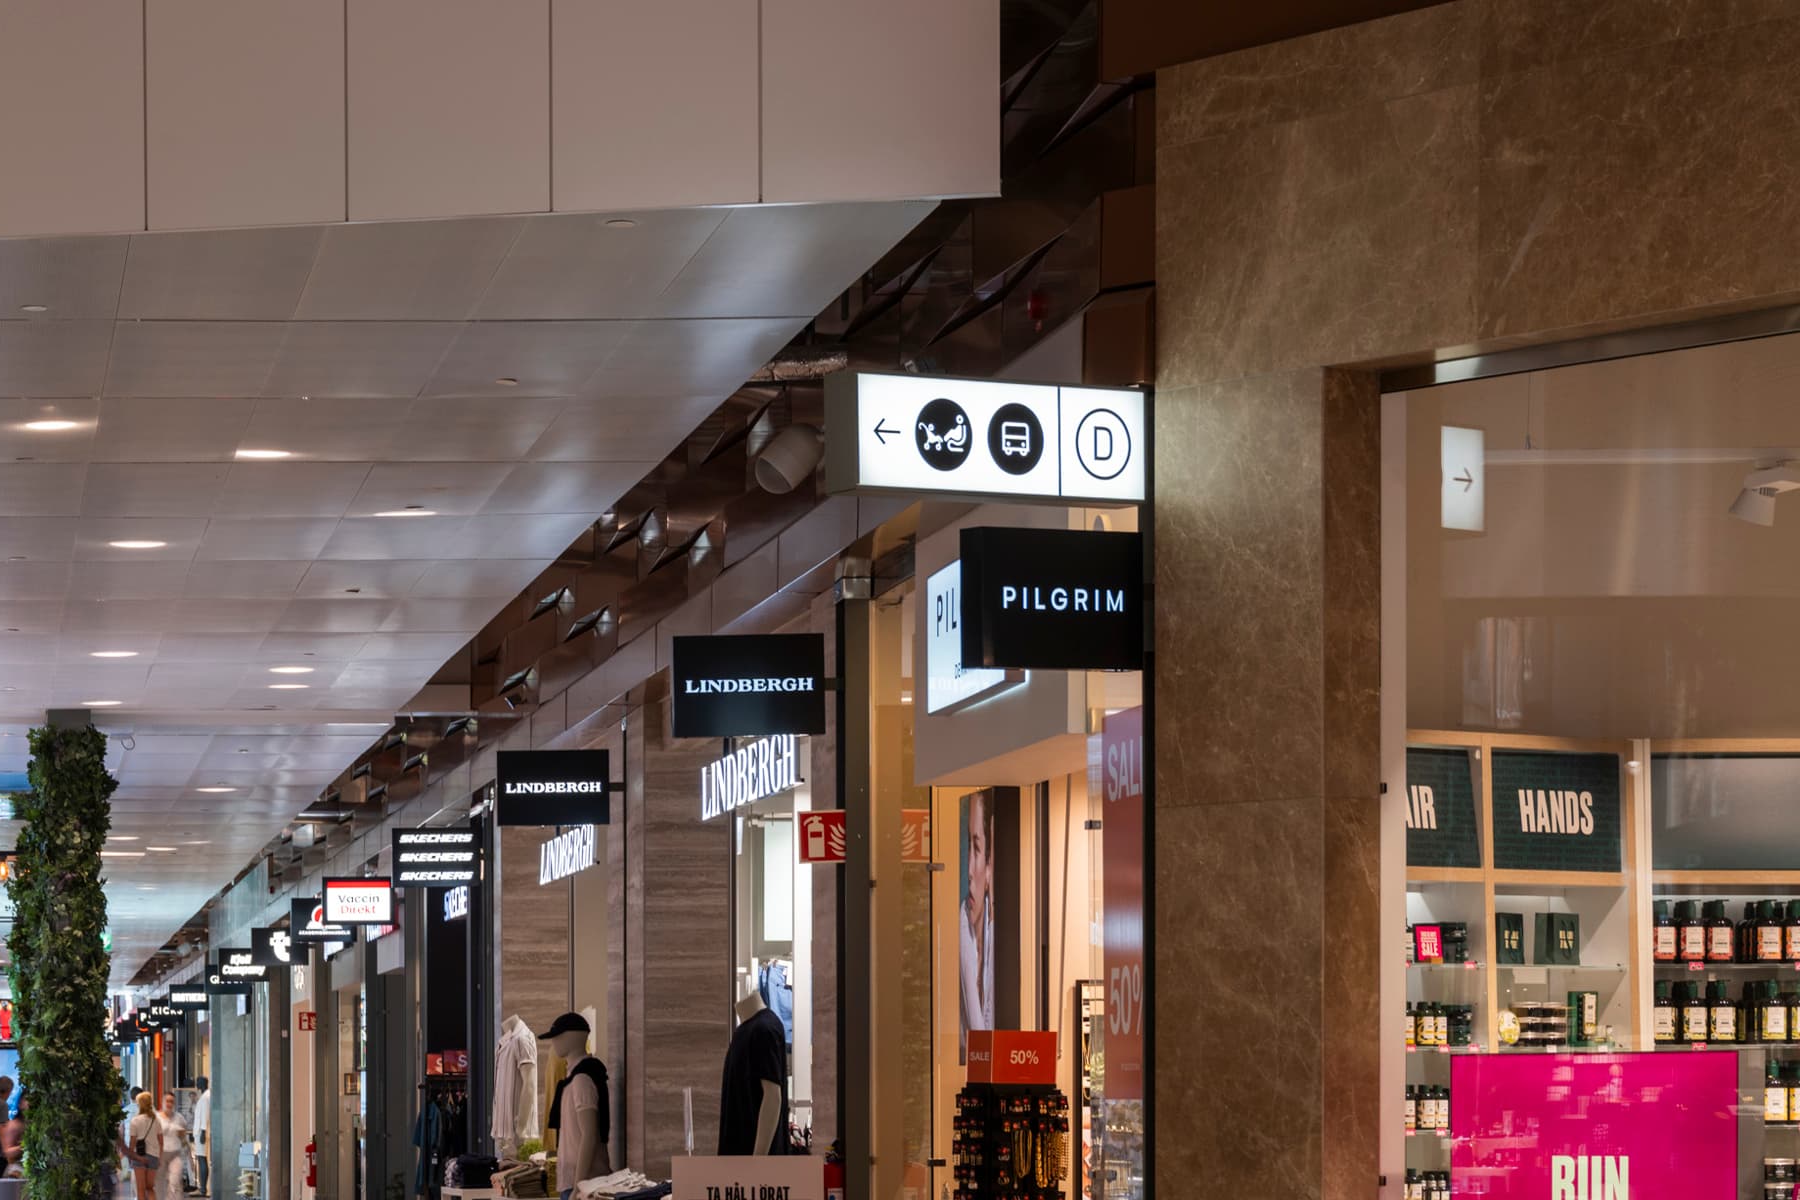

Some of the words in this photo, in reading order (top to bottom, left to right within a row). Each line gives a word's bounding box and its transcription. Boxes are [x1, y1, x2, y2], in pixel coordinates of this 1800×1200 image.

[1094, 426, 1113, 462] D
[1002, 586, 1125, 612] PILGRIM
[685, 677, 814, 694] LINDBERGH
[701, 733, 796, 821] LINDBERGH
[1107, 735, 1142, 802] SAL
[505, 781, 602, 795] LINDBERGH
[1406, 785, 1438, 830] AIR
[1518, 788, 1595, 836] HANDS
[399, 834, 474, 843] SKECHERS
[399, 852, 474, 862] SKECHERS
[539, 824, 595, 886] LINDBERGH
[399, 871, 474, 881] SKECHERS
[338, 895, 380, 903] Vaccin
[340, 905, 377, 914] Direkt
[969, 1052, 990, 1061] SALE
[1009, 1050, 1040, 1066] 50%
[706, 1186, 721, 1200] TA
[725, 1182, 747, 1200] HÅL
[751, 1186, 756, 1200] I
[760, 1184, 790, 1200] ÖRAT
